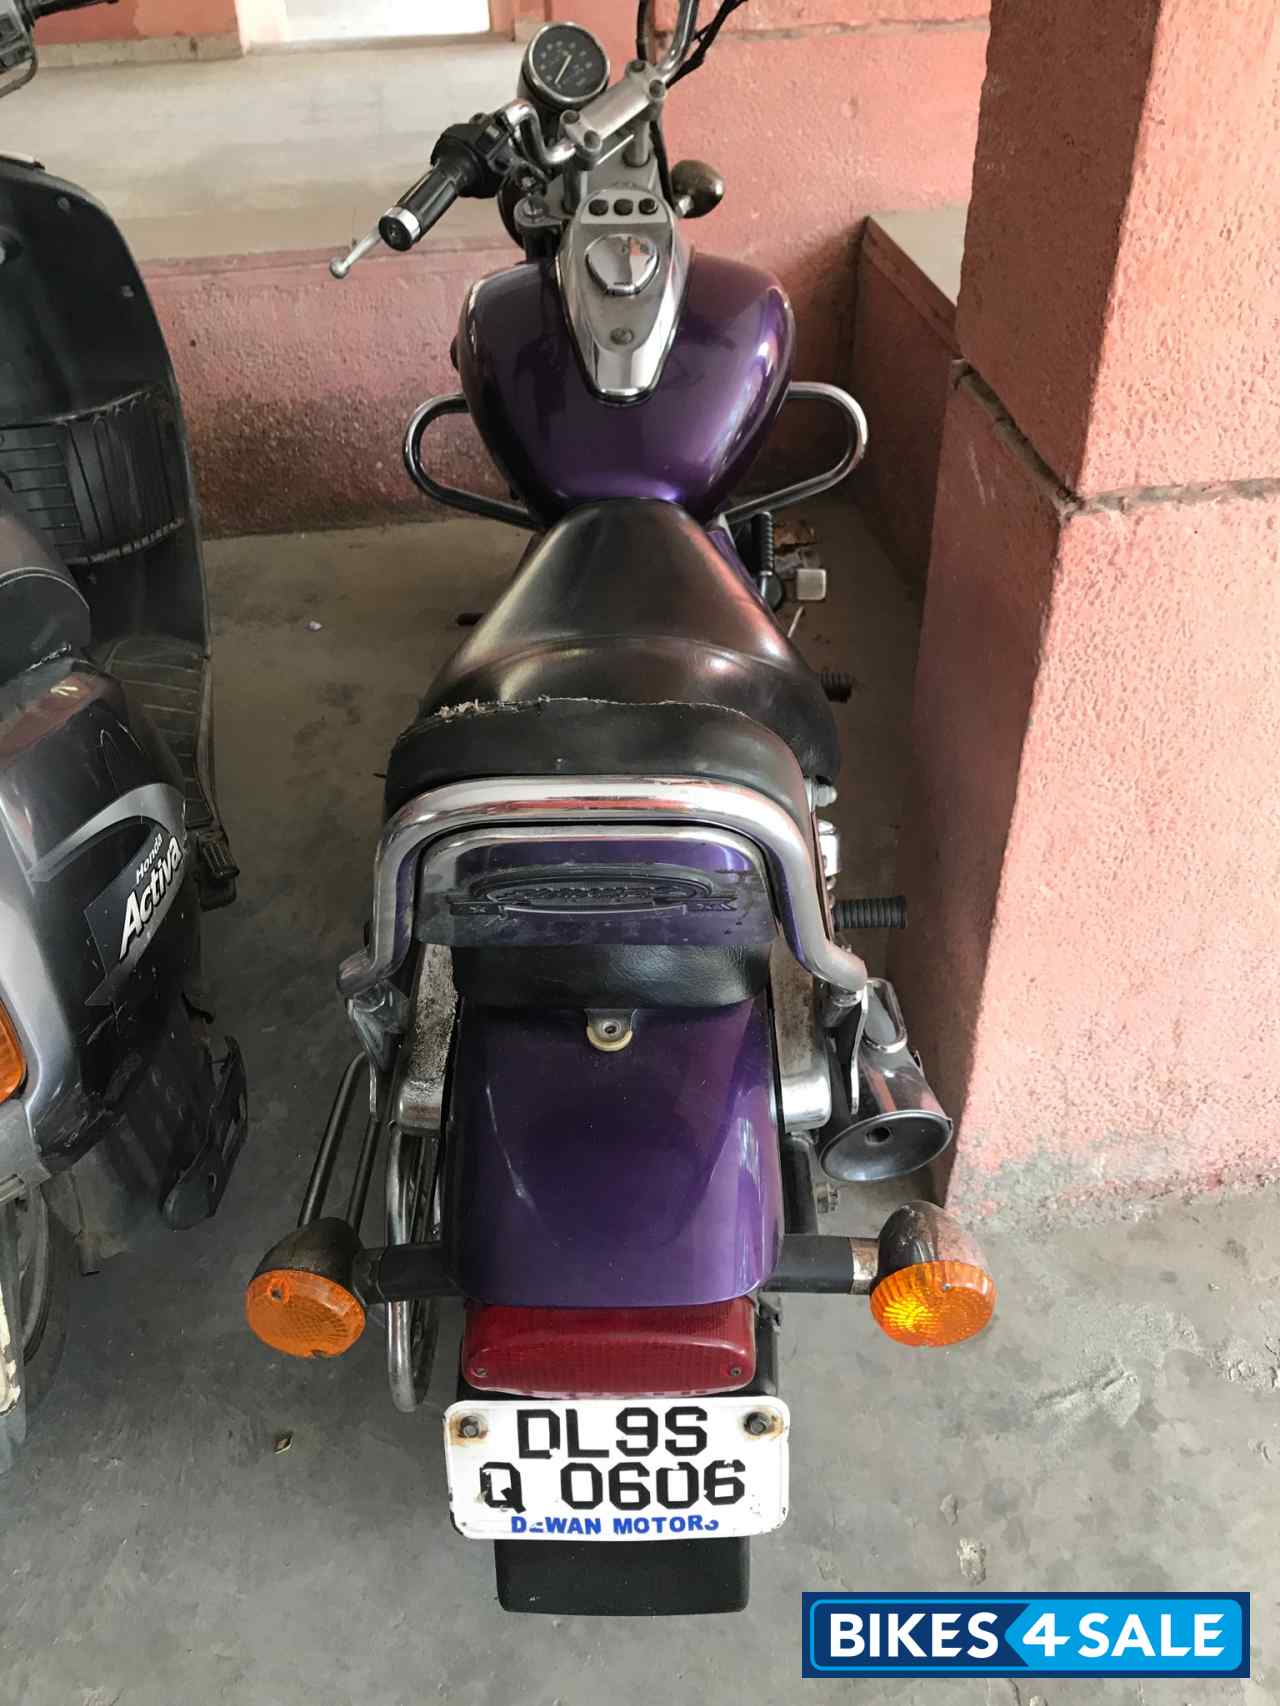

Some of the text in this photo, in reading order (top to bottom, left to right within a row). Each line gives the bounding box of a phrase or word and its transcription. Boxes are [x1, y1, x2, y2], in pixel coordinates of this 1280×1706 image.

[119, 836, 184, 961] Activa
[516, 1406, 708, 1459] DL9S
[479, 1459, 746, 1514] Q 0606
